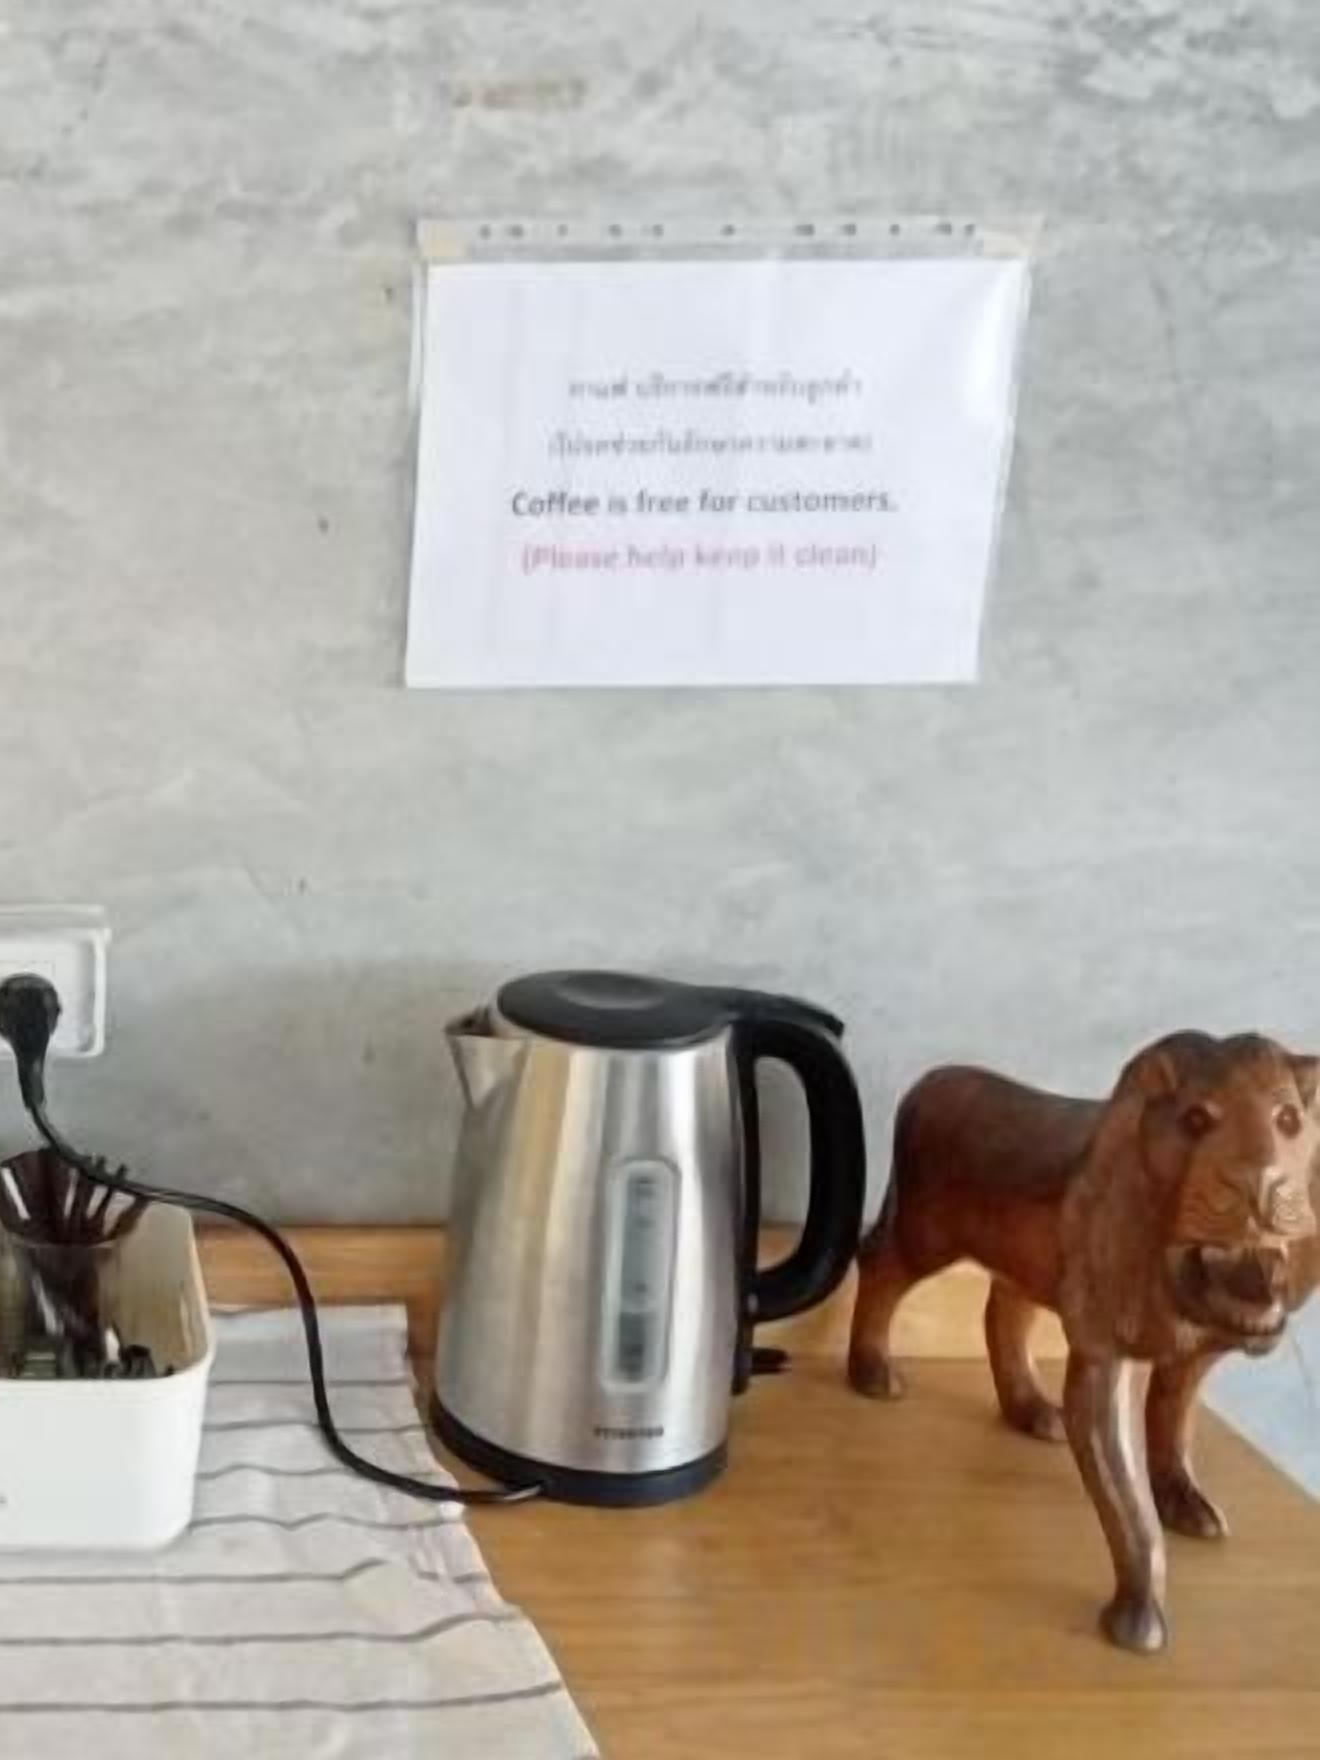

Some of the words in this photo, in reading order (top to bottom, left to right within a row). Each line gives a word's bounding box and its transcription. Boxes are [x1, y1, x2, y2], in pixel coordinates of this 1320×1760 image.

[511, 489, 601, 517] Coffee
[607, 491, 629, 515] is
[635, 488, 690, 515] free
[698, 487, 739, 515] for
[746, 489, 899, 515] customers.
[627, 542, 686, 573] help
